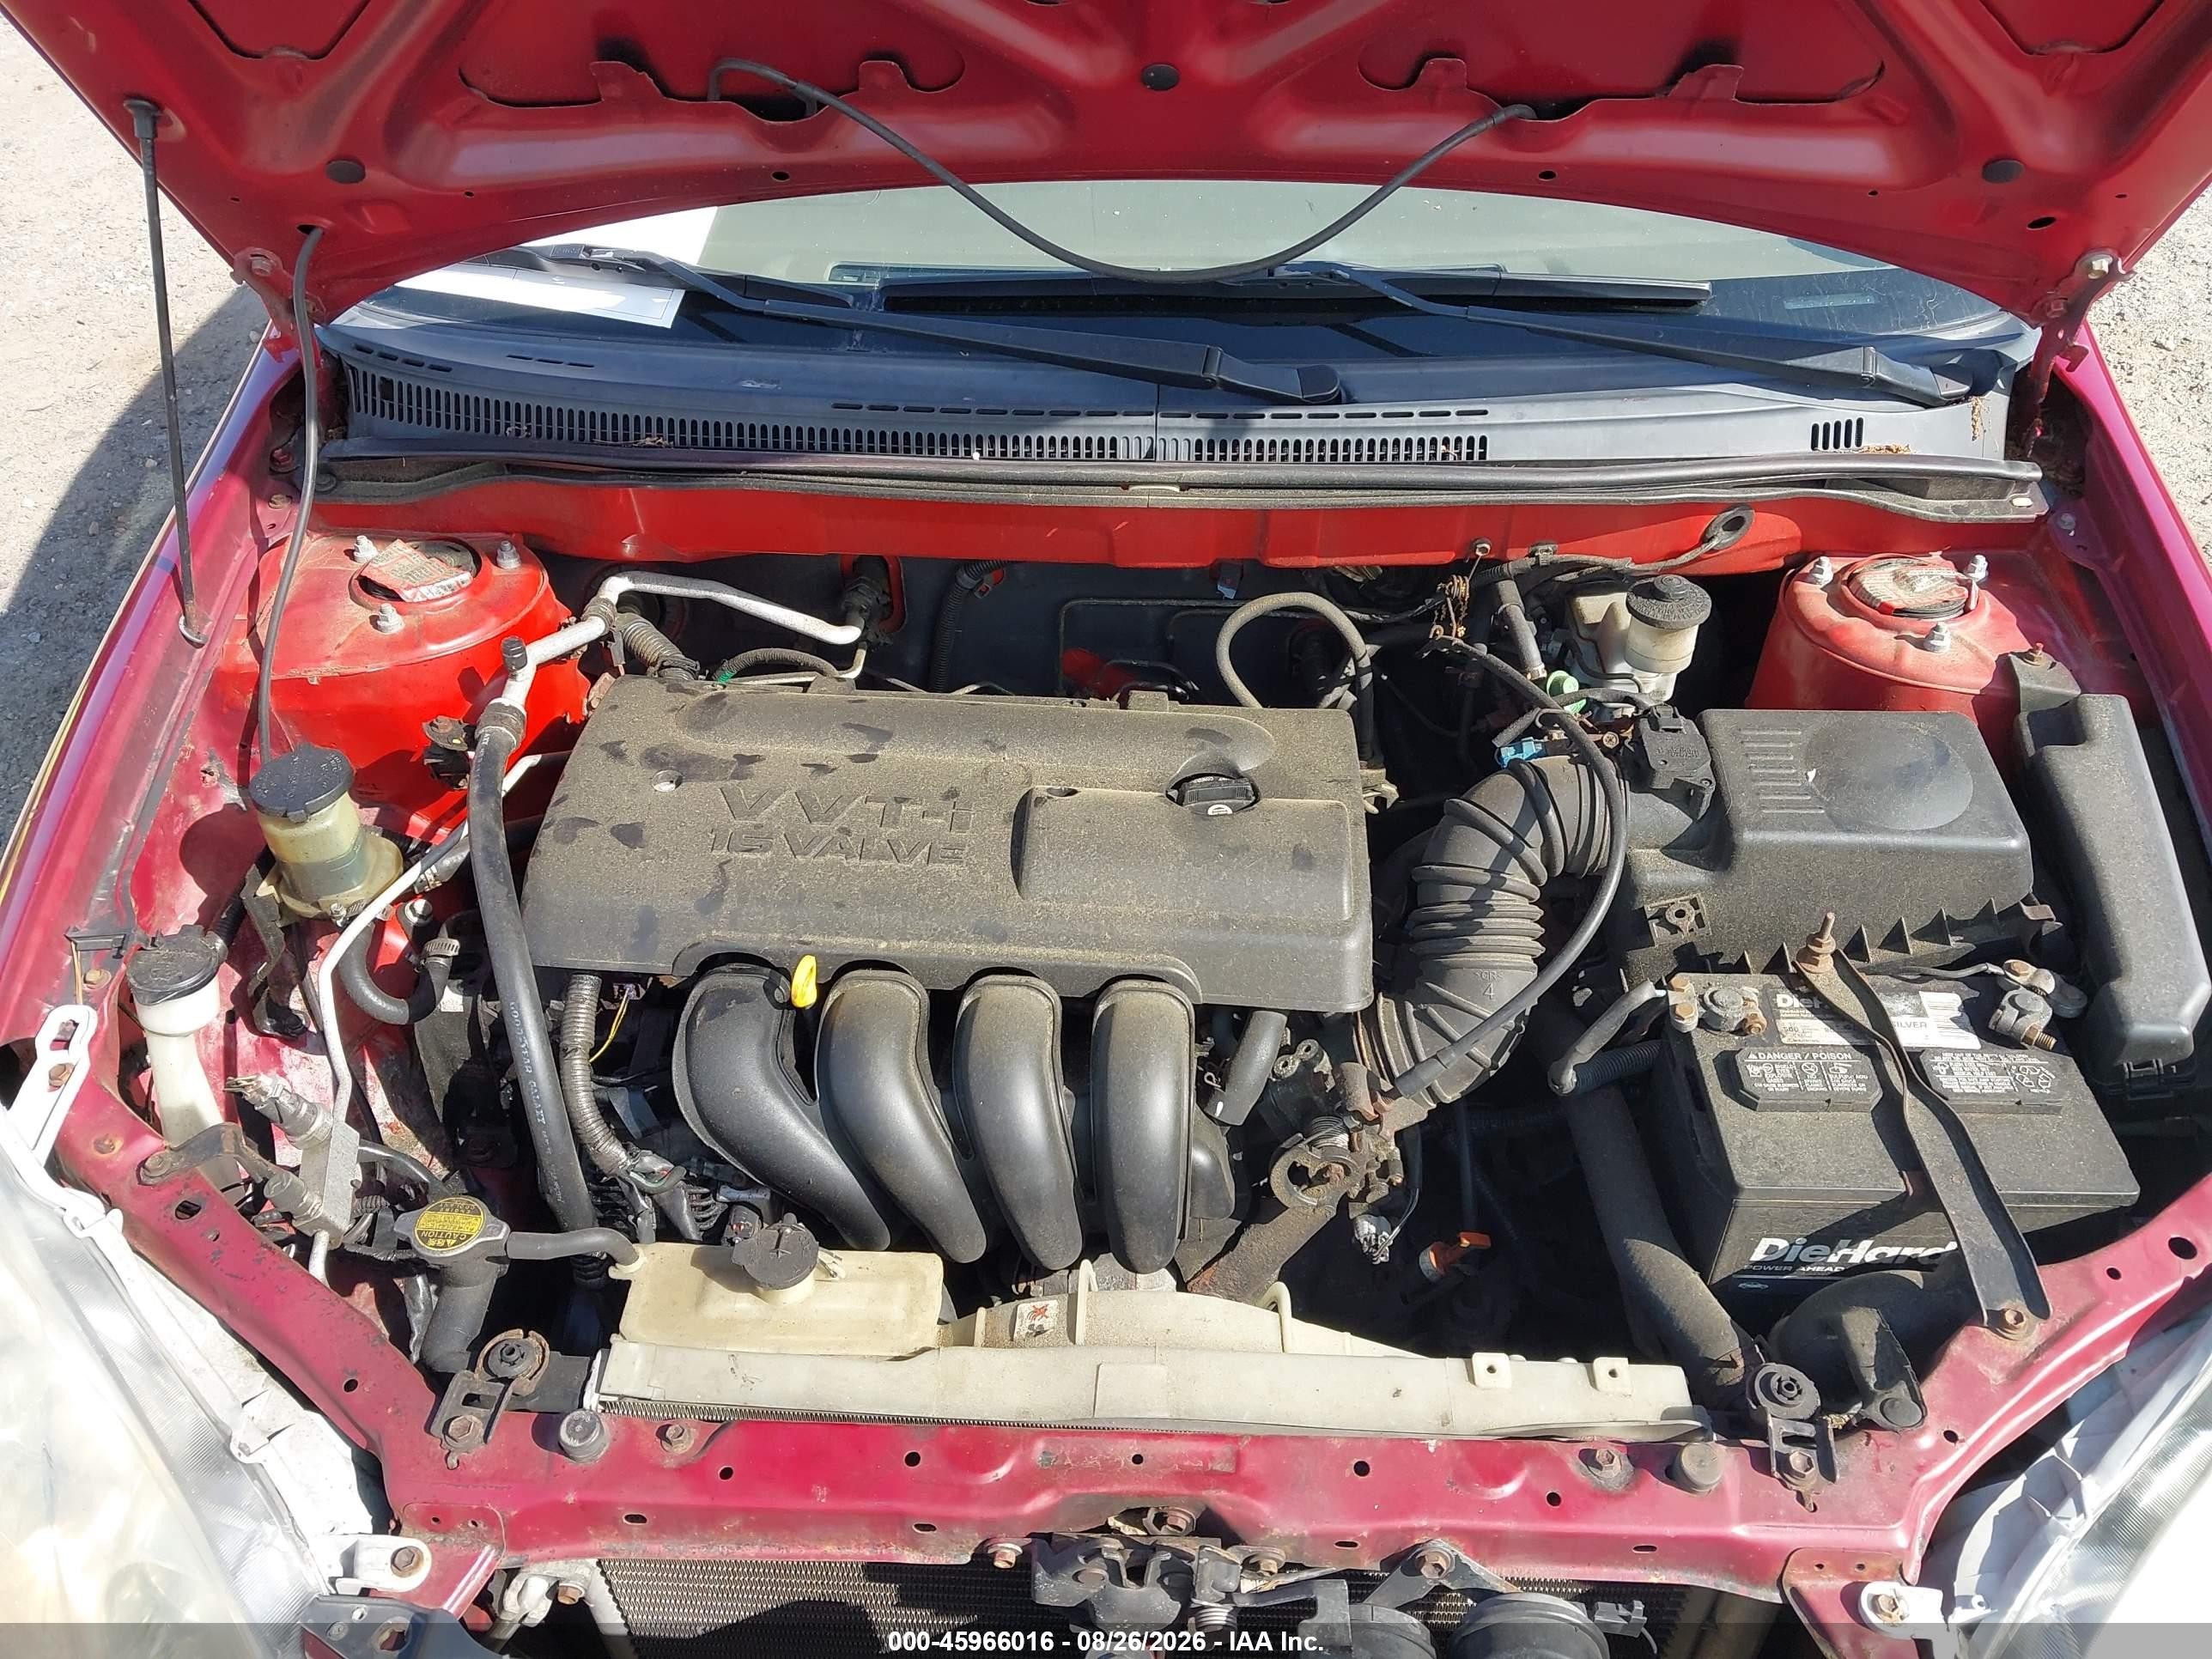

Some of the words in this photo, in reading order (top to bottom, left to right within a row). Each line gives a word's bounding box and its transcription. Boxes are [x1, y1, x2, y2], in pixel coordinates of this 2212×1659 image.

[709, 829, 773, 856] 16
[783, 832, 969, 866] VALVE
[1812, 1052, 1852, 1060] POISON
[420, 1230, 466, 1241] CAUTION
